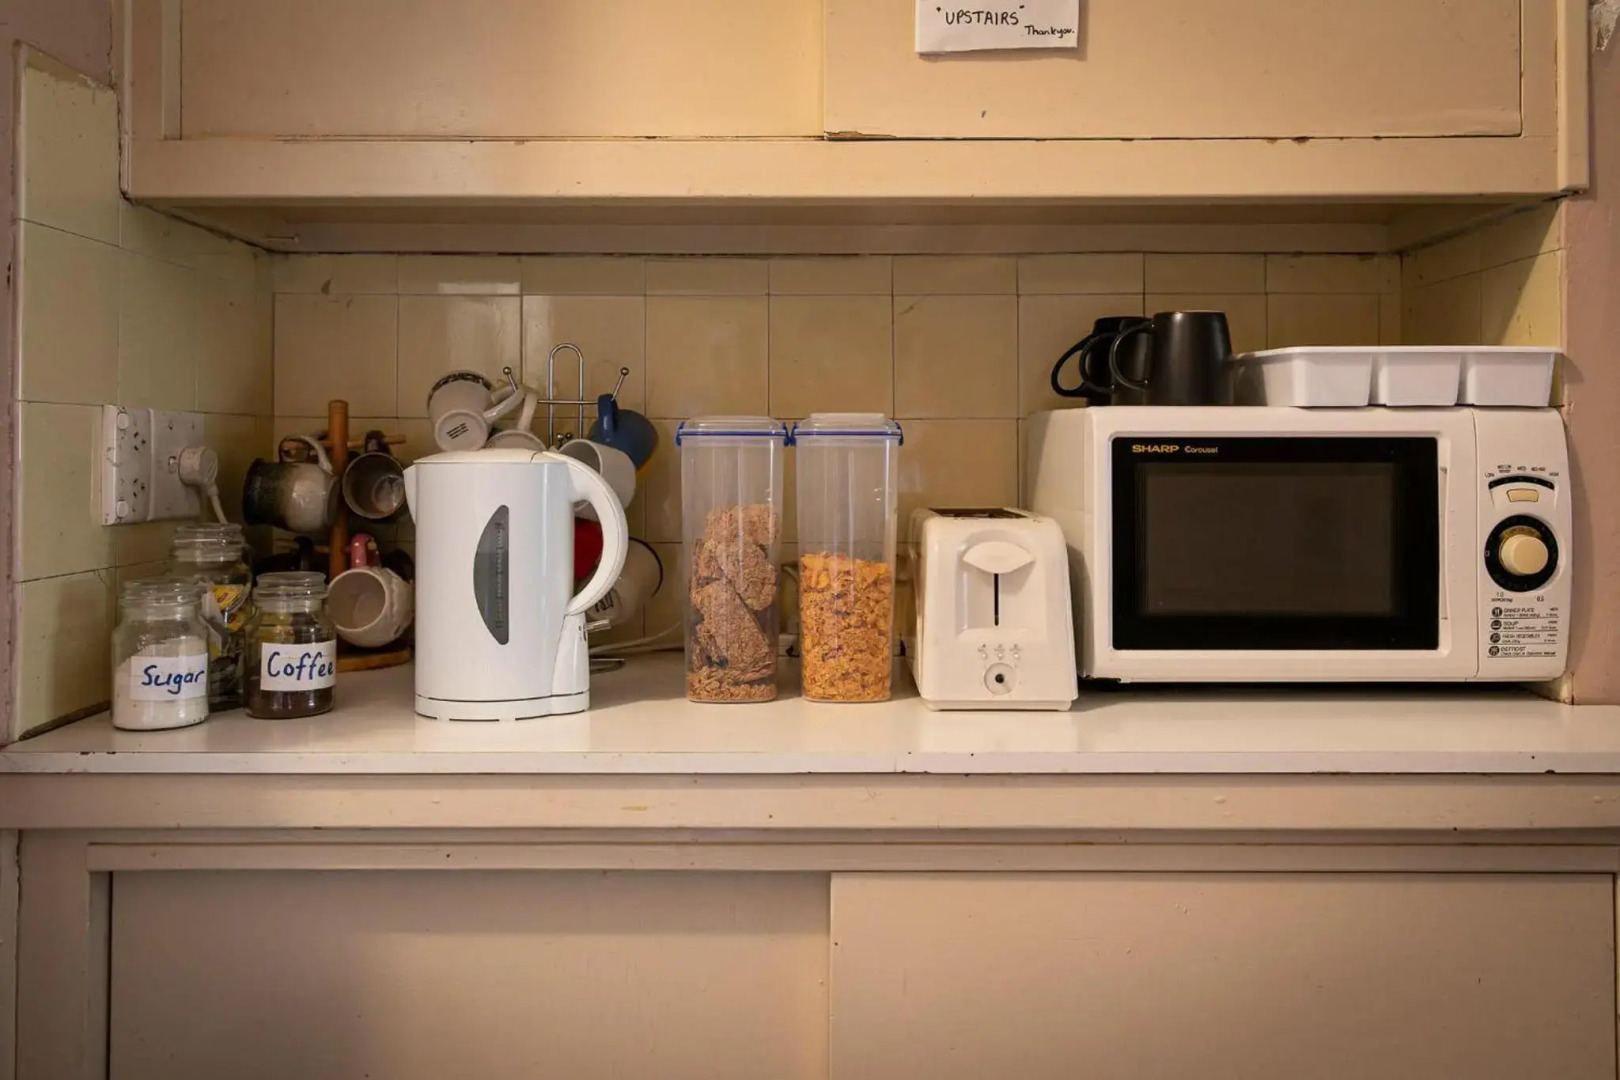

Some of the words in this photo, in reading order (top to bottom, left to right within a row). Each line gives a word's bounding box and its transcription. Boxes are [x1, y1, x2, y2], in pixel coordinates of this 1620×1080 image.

[1132, 444, 1180, 454] SHARP
[1184, 445, 1219, 454] Carousel
[141, 664, 205, 695] Sugar
[267, 651, 335, 681] Coffee
